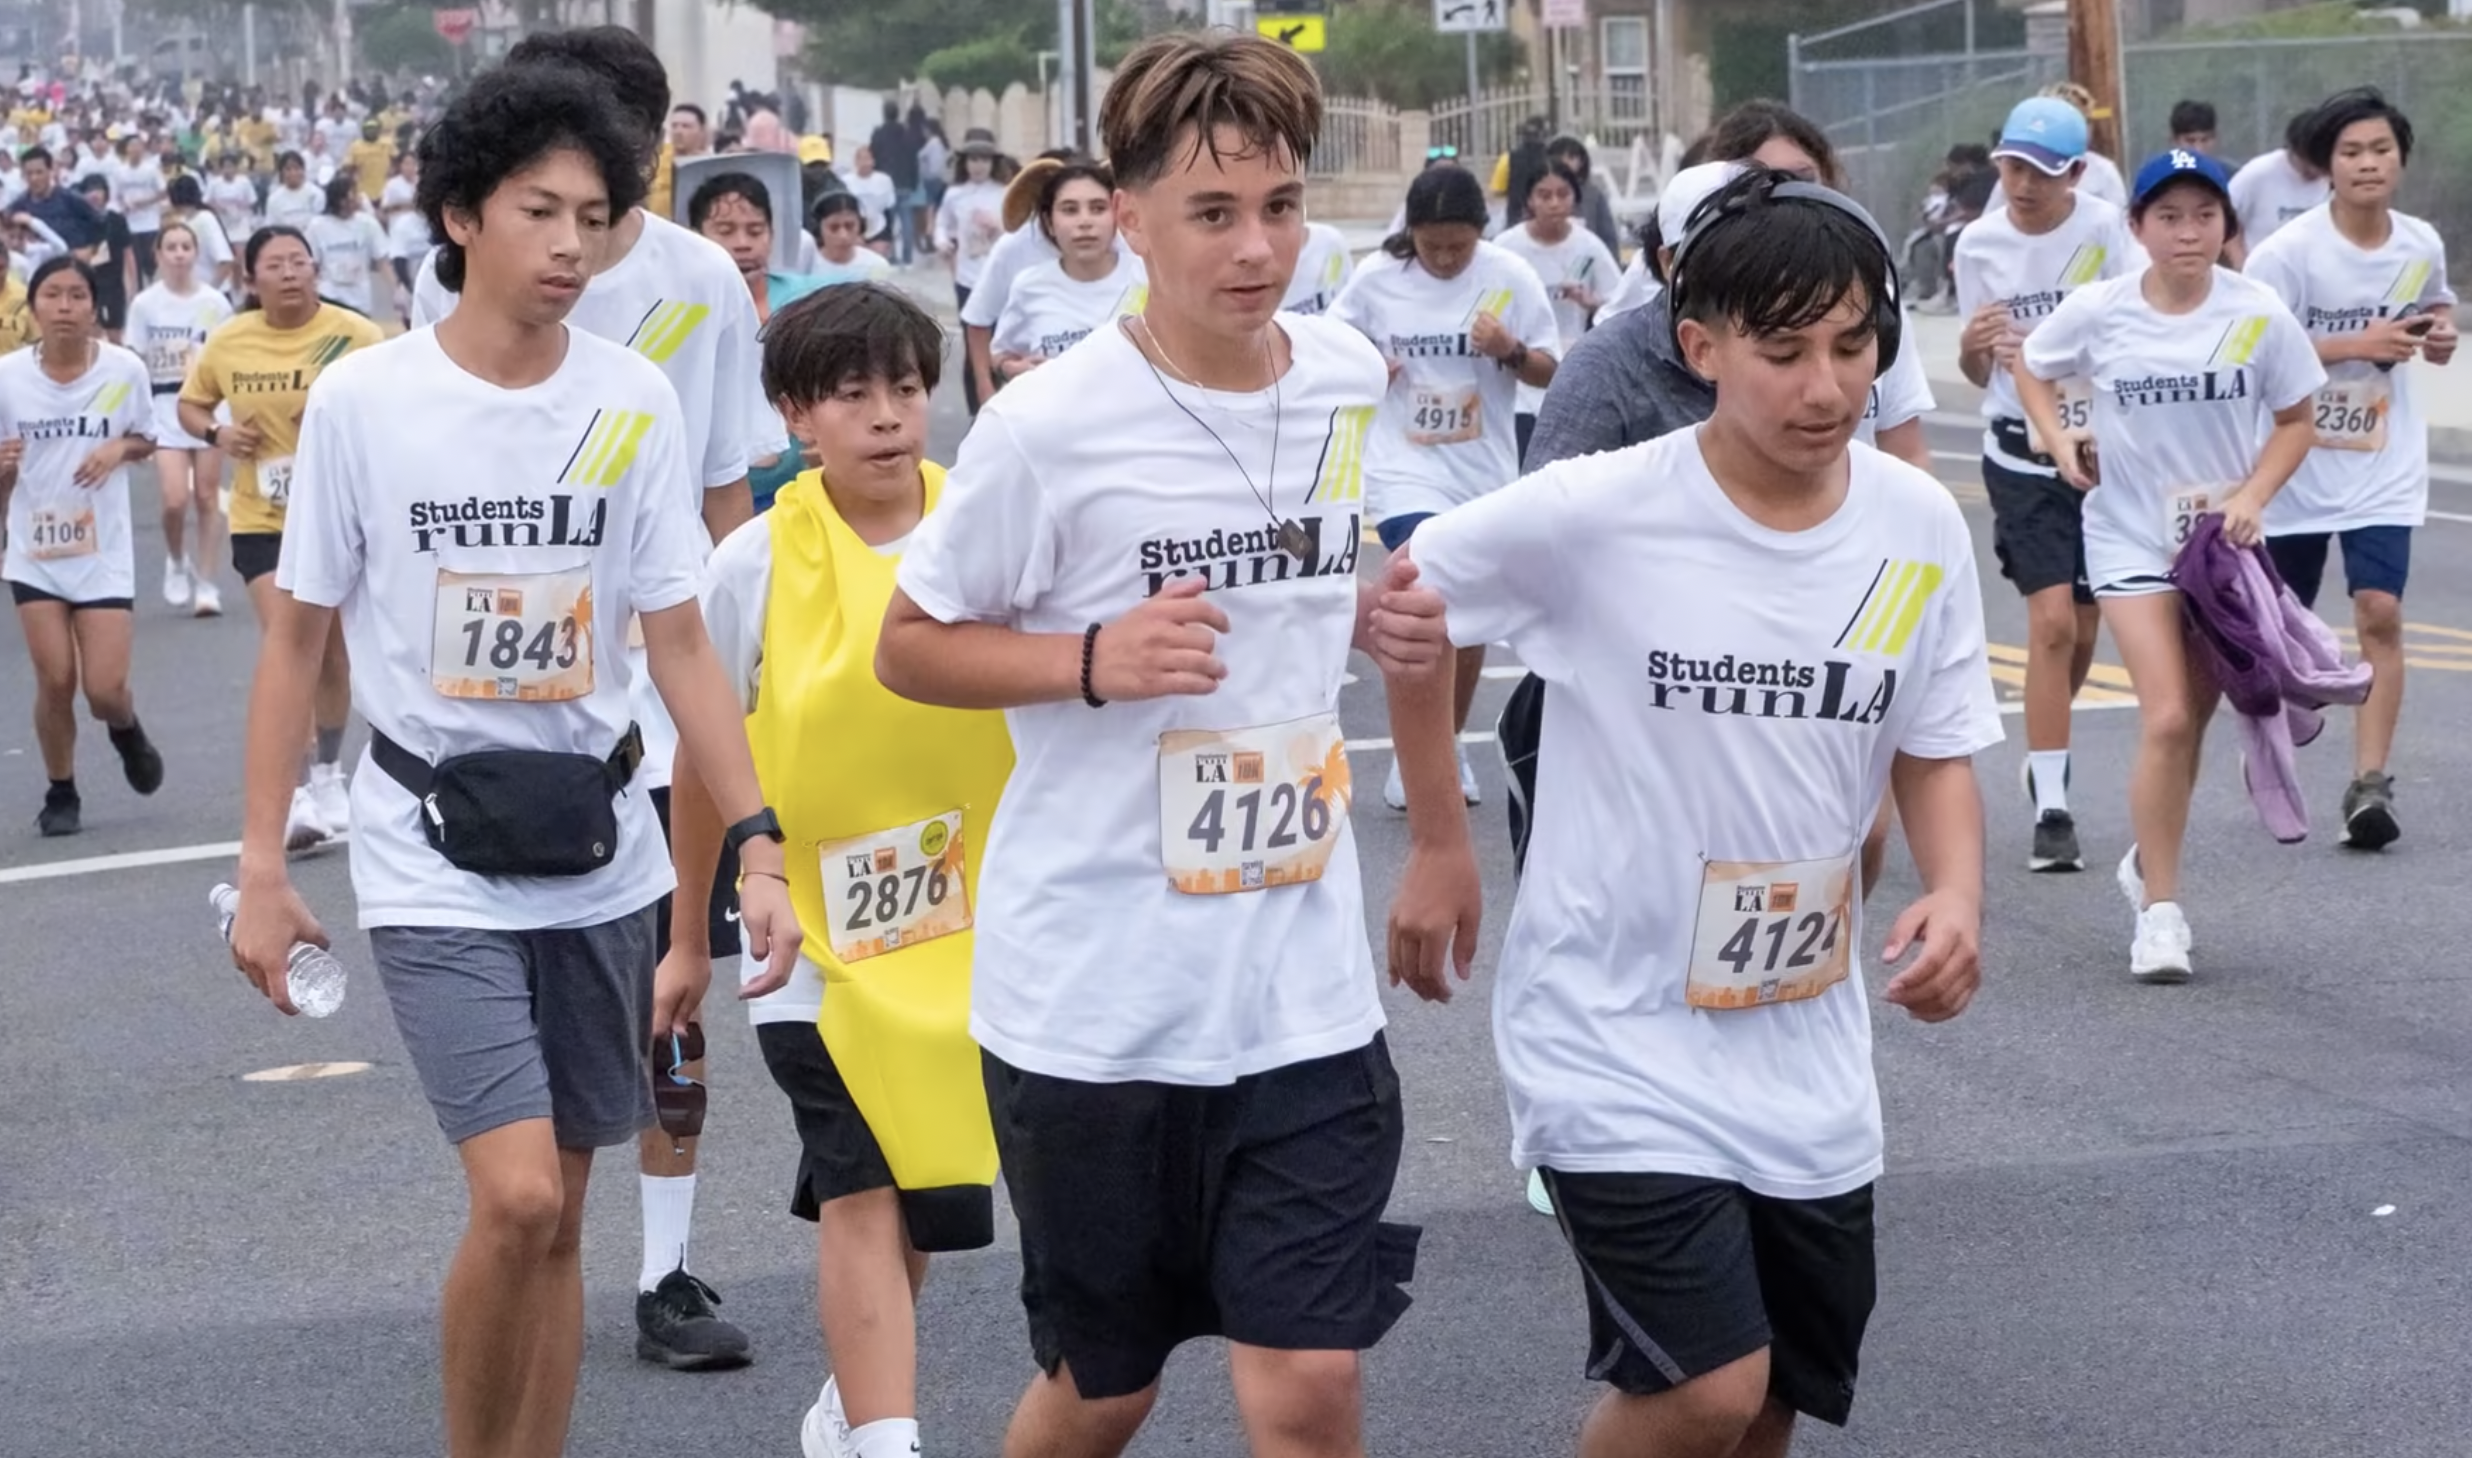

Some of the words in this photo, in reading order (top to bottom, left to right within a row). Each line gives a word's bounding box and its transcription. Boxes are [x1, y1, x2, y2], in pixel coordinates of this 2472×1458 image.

[2170, 149, 2197, 168] LA
[1390, 334, 1453, 348] Students
[2114, 376, 2198, 393] Students
[2119, 389, 2196, 405] run
[2203, 369, 2246, 400] LA
[2315, 404, 2378, 433] 2360
[410, 497, 544, 527] Students
[411, 522, 545, 553] run
[547, 495, 607, 546] LA
[33, 522, 86, 546] 4106
[1140, 522, 1283, 569] Student
[1296, 513, 1360, 578] LA
[462, 616, 577, 670] 1843
[1648, 649, 1816, 689] Students
[1648, 680, 1810, 720] run
[1815, 660, 1896, 724] LA
[1196, 764, 1227, 783] LA
[1187, 776, 1329, 853] 4126
[845, 856, 948, 931] 2876
